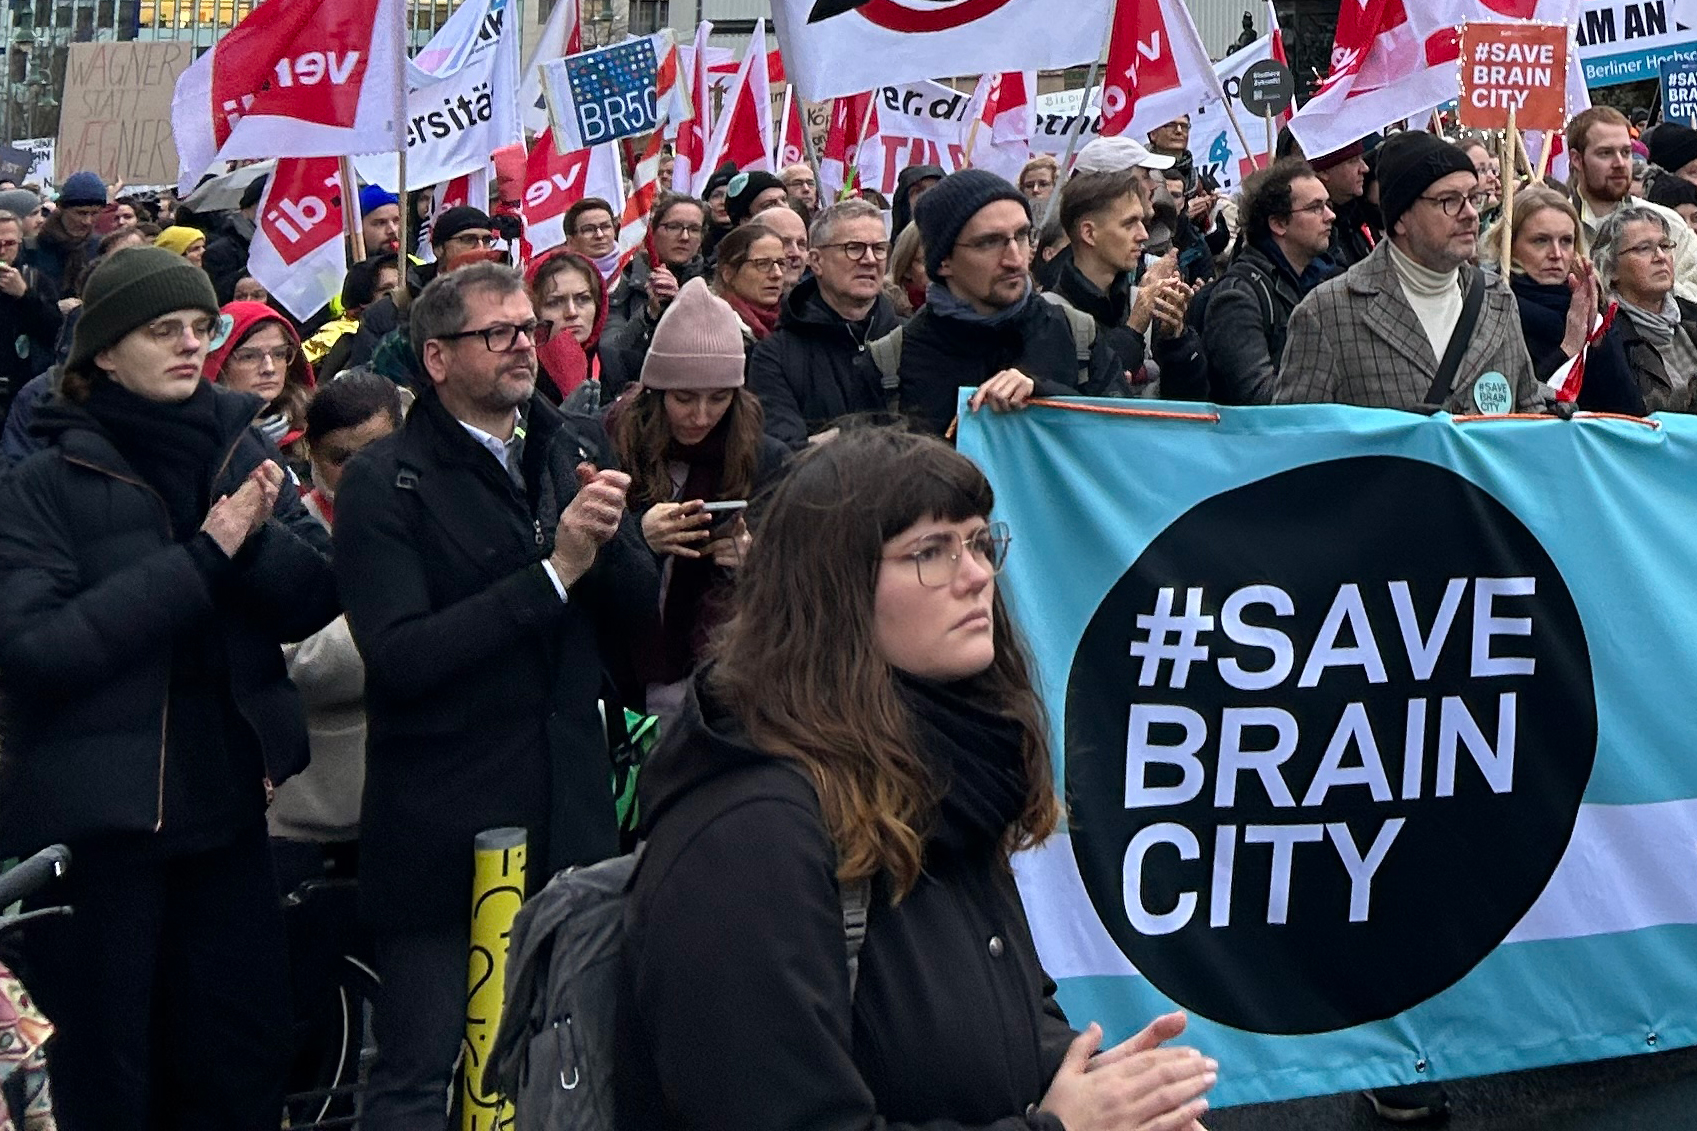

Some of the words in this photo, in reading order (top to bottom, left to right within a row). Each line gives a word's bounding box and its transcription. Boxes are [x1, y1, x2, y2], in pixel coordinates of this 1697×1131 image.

[1624, 0, 1668, 40] AN
[70, 42, 182, 87] WAGNER
[1474, 41, 1555, 65] #SAVE
[1586, 57, 1644, 81] Berliner
[1472, 64, 1552, 88] BRAIN
[81, 89, 147, 119] STATT
[1471, 87, 1530, 109] CITY
[1129, 576, 1537, 690] #SAVE
[1124, 692, 1517, 809] BRAIN
[1122, 817, 1406, 936] CITY
